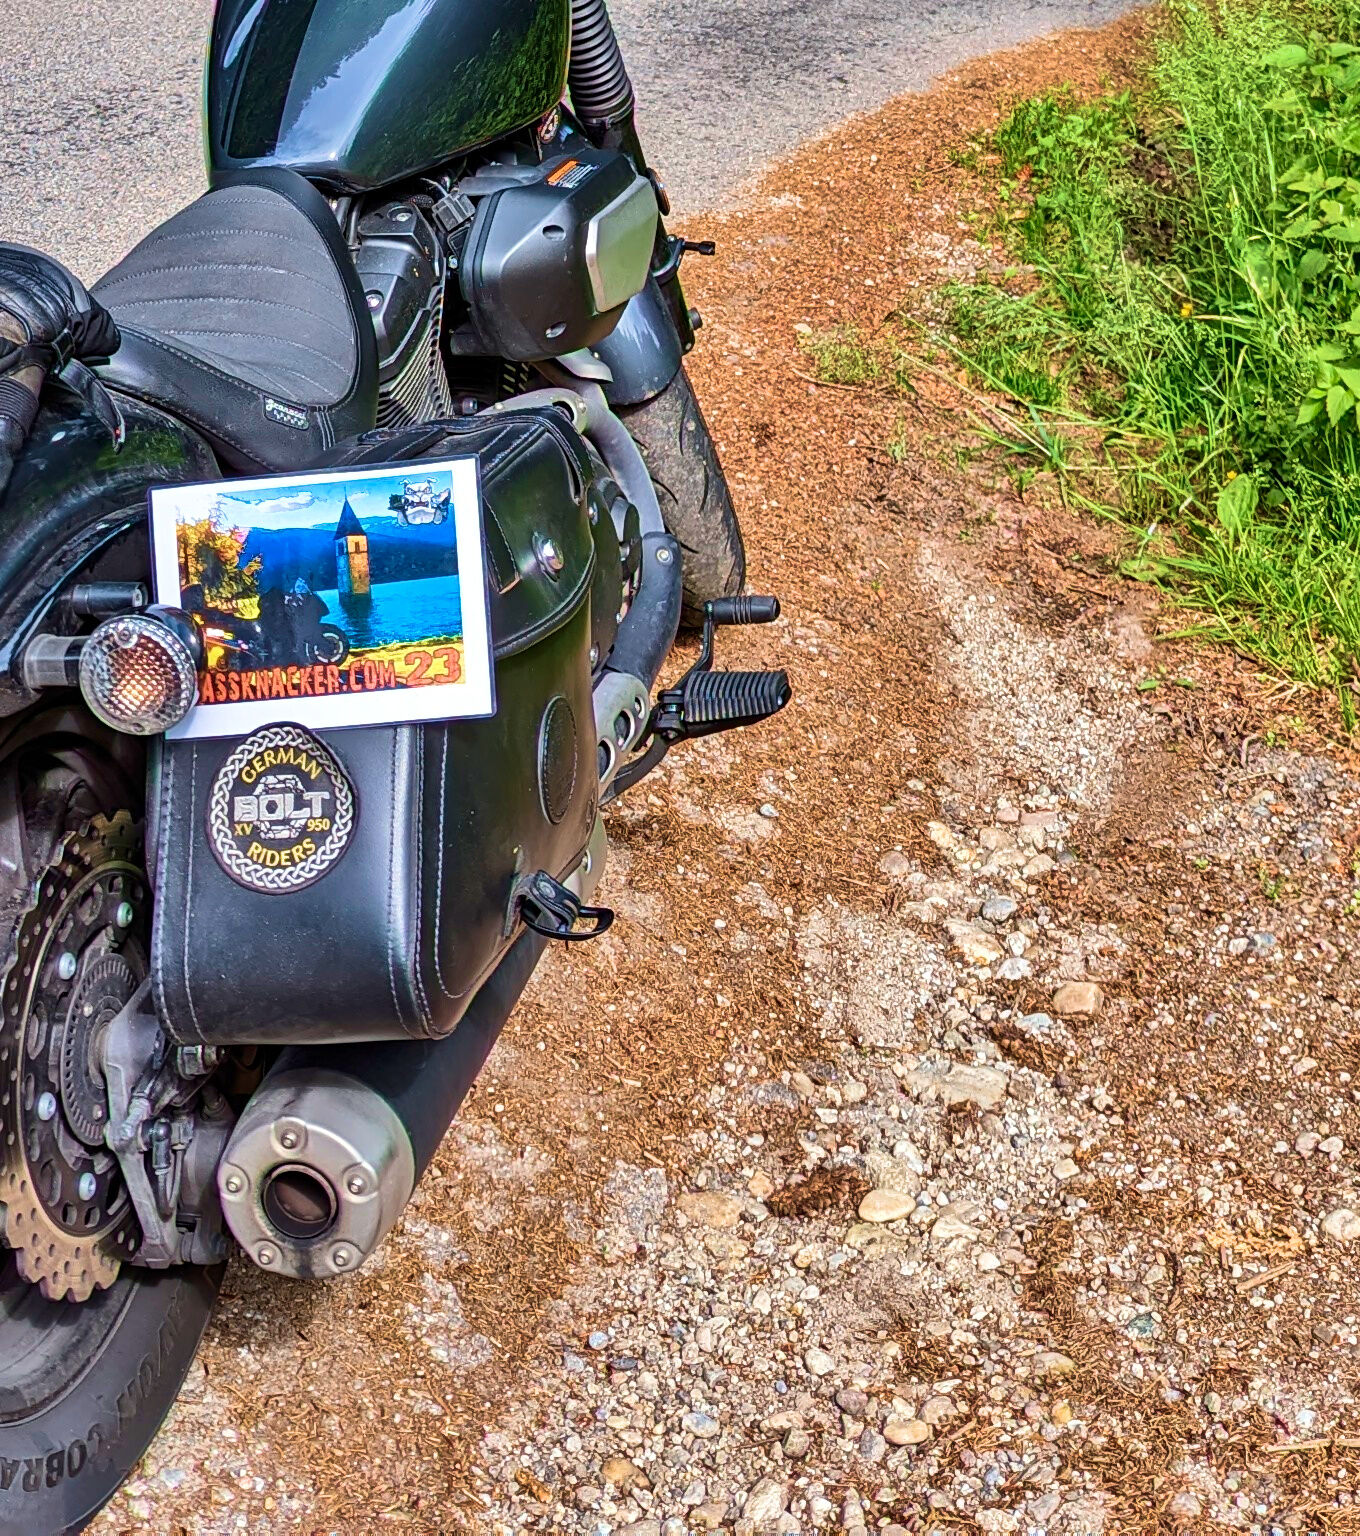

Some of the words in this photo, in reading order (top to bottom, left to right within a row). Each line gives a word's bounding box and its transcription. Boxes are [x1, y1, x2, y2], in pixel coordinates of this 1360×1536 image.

[200, 659, 396, 704] ASSKNACKER.COM
[403, 647, 462, 686] 23
[241, 747, 323, 784] GERMAN
[233, 791, 331, 822] BOLT
[234, 823, 254, 836] XV
[306, 818, 331, 832] 950
[246, 837, 317, 867] RIDERS
[0, 1423, 103, 1493] COBRA
